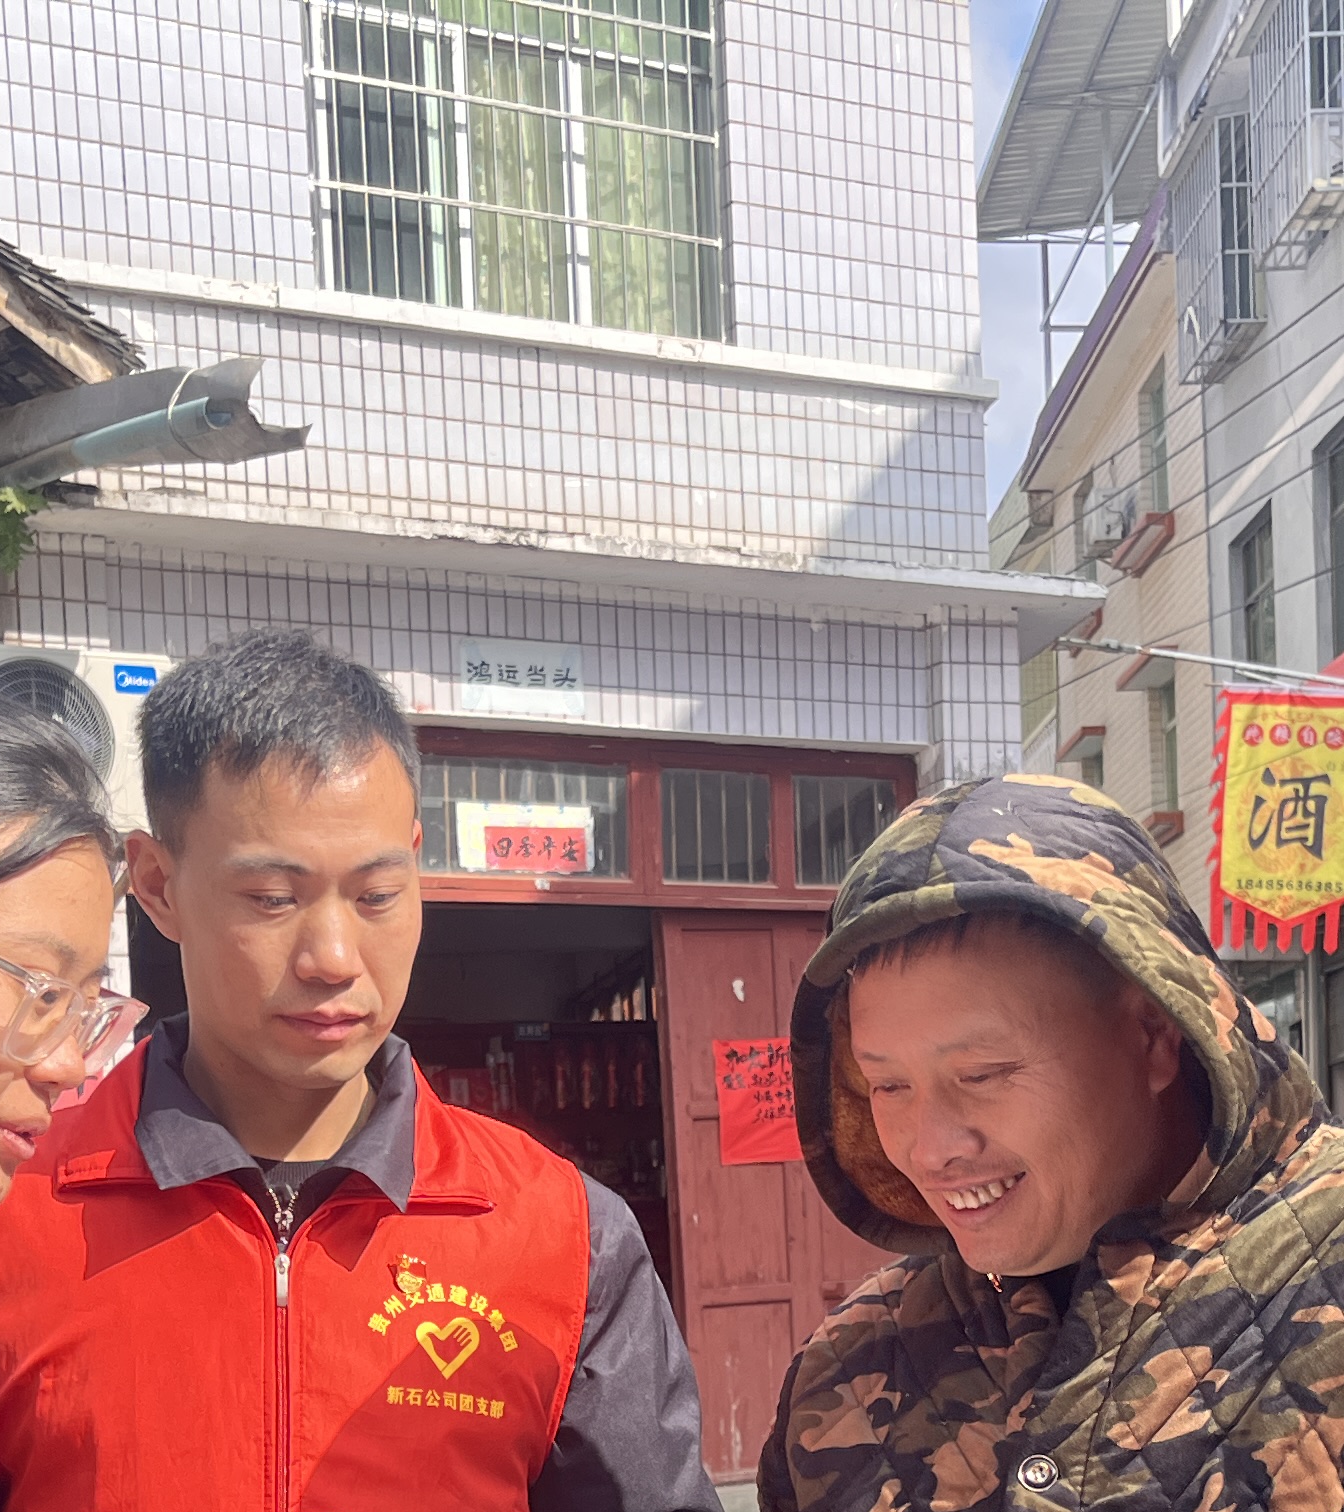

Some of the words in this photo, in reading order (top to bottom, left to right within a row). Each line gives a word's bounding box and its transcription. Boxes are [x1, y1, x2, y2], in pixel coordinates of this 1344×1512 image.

[466, 660, 577, 689] 鸿运当头
[1247, 767, 1331, 860] 酒
[367, 1282, 519, 1353] 贵州交通建设集团
[386, 1384, 505, 1420] 新石公司团支部
